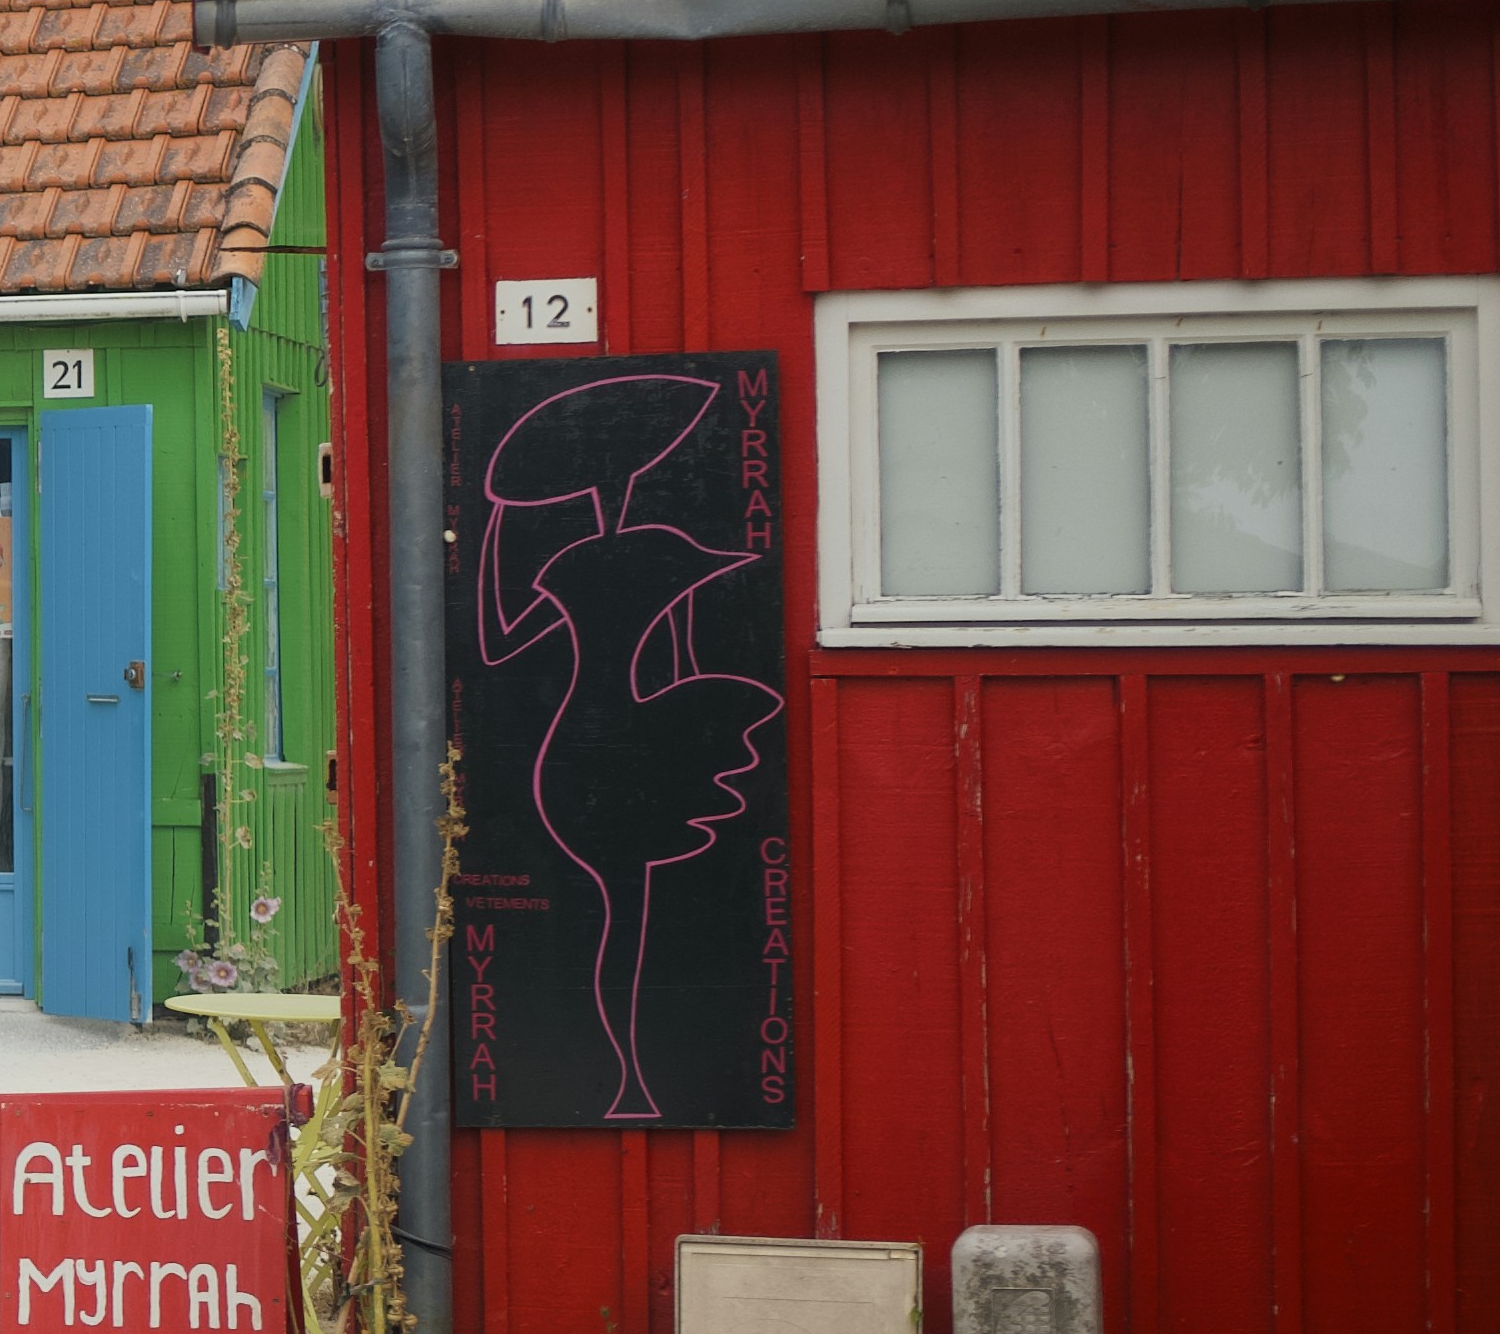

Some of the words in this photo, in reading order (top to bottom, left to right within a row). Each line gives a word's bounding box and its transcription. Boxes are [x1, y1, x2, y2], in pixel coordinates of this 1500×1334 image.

[521, 294, 571, 329] 12
[51, 359, 84, 390] 21
[450, 403, 462, 487] ATELIER
[737, 368, 772, 549] MYRRAH
[453, 873, 531, 886] CREATIONS
[466, 897, 550, 911] VETEMENTS
[760, 836, 789, 1104] CREATIONS
[466, 923, 497, 1102] MYRRAH
[12, 1124, 279, 1221] Atelier
